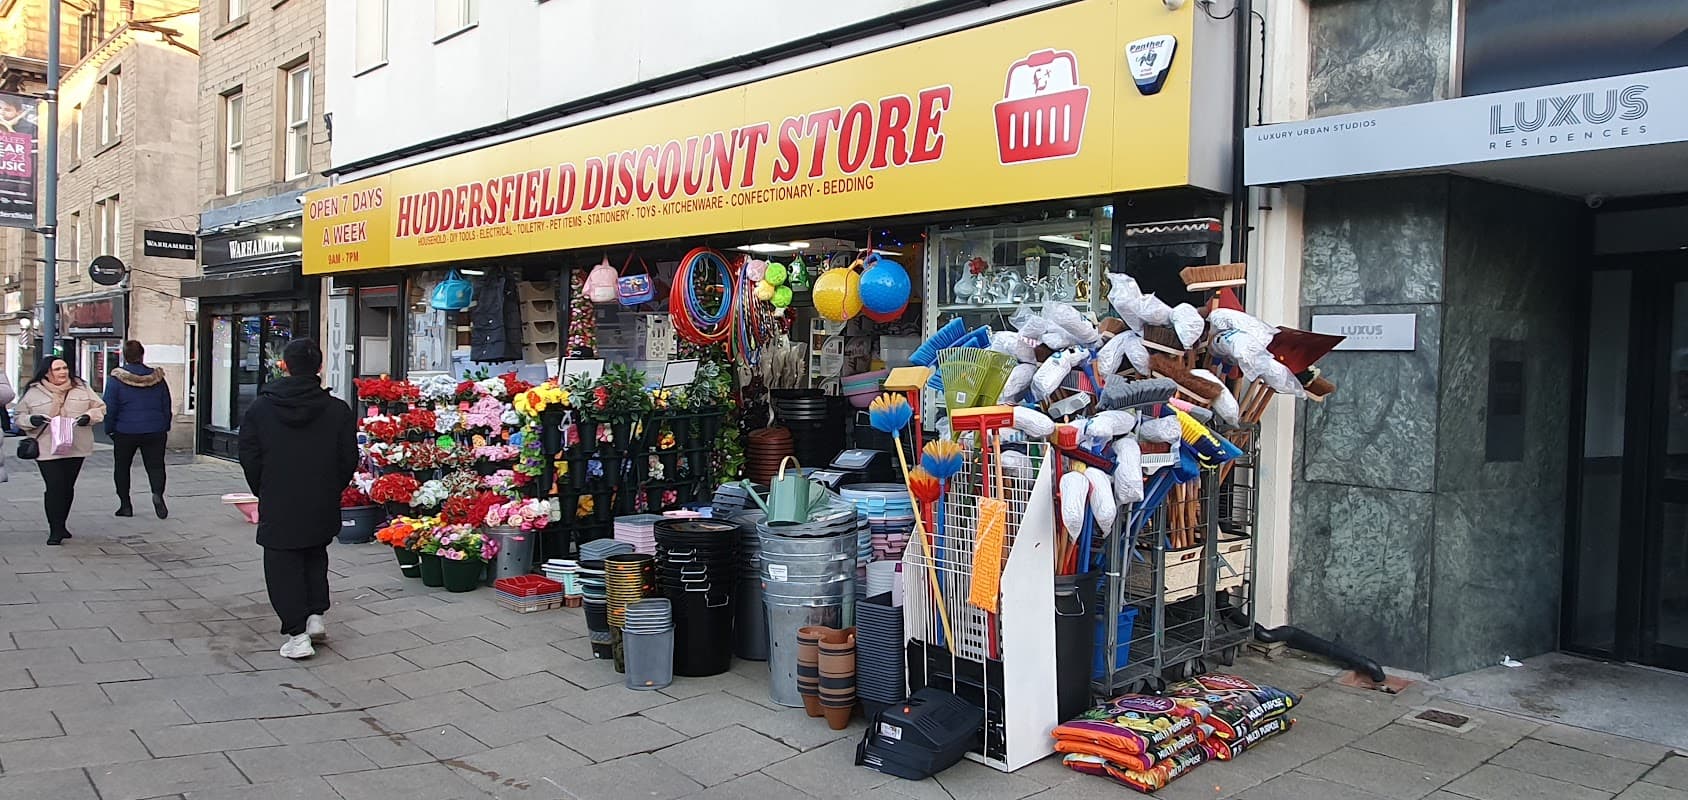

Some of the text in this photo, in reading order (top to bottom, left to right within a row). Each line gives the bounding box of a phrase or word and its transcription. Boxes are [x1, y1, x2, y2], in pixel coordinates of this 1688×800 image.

[1490, 84, 1650, 136] LUXUS
[1258, 119, 1376, 142] LUXURY URBAN STUDIOS
[1490, 125, 1648, 150] RESIDENCES
[395, 85, 952, 238] HUDDERSFIELD DISCOUNT STORE
[310, 187, 383, 220] OPEN 7 DAYS
[459, 230, 476, 242] TOOLS
[480, 226, 512, 239] ELECTRICAL
[517, 221, 544, 234] TOILETRY
[550, 218, 561, 230] PET
[563, 216, 582, 228] ITEMS
[588, 209, 631, 226] STATIONERY
[636, 205, 656, 219] TOYS
[663, 196, 724, 216] KITCHENWARE
[731, 183, 814, 207] CONFECTIONARY
[823, 175, 874, 195] BEDDING
[322, 221, 366, 246] A WEEK
[346, 250, 359, 263] 7PM
[1340, 324, 1384, 336] LUXUS
[1152, 729, 1169, 744] MULTI
[1158, 743, 1176, 760] MULTI
